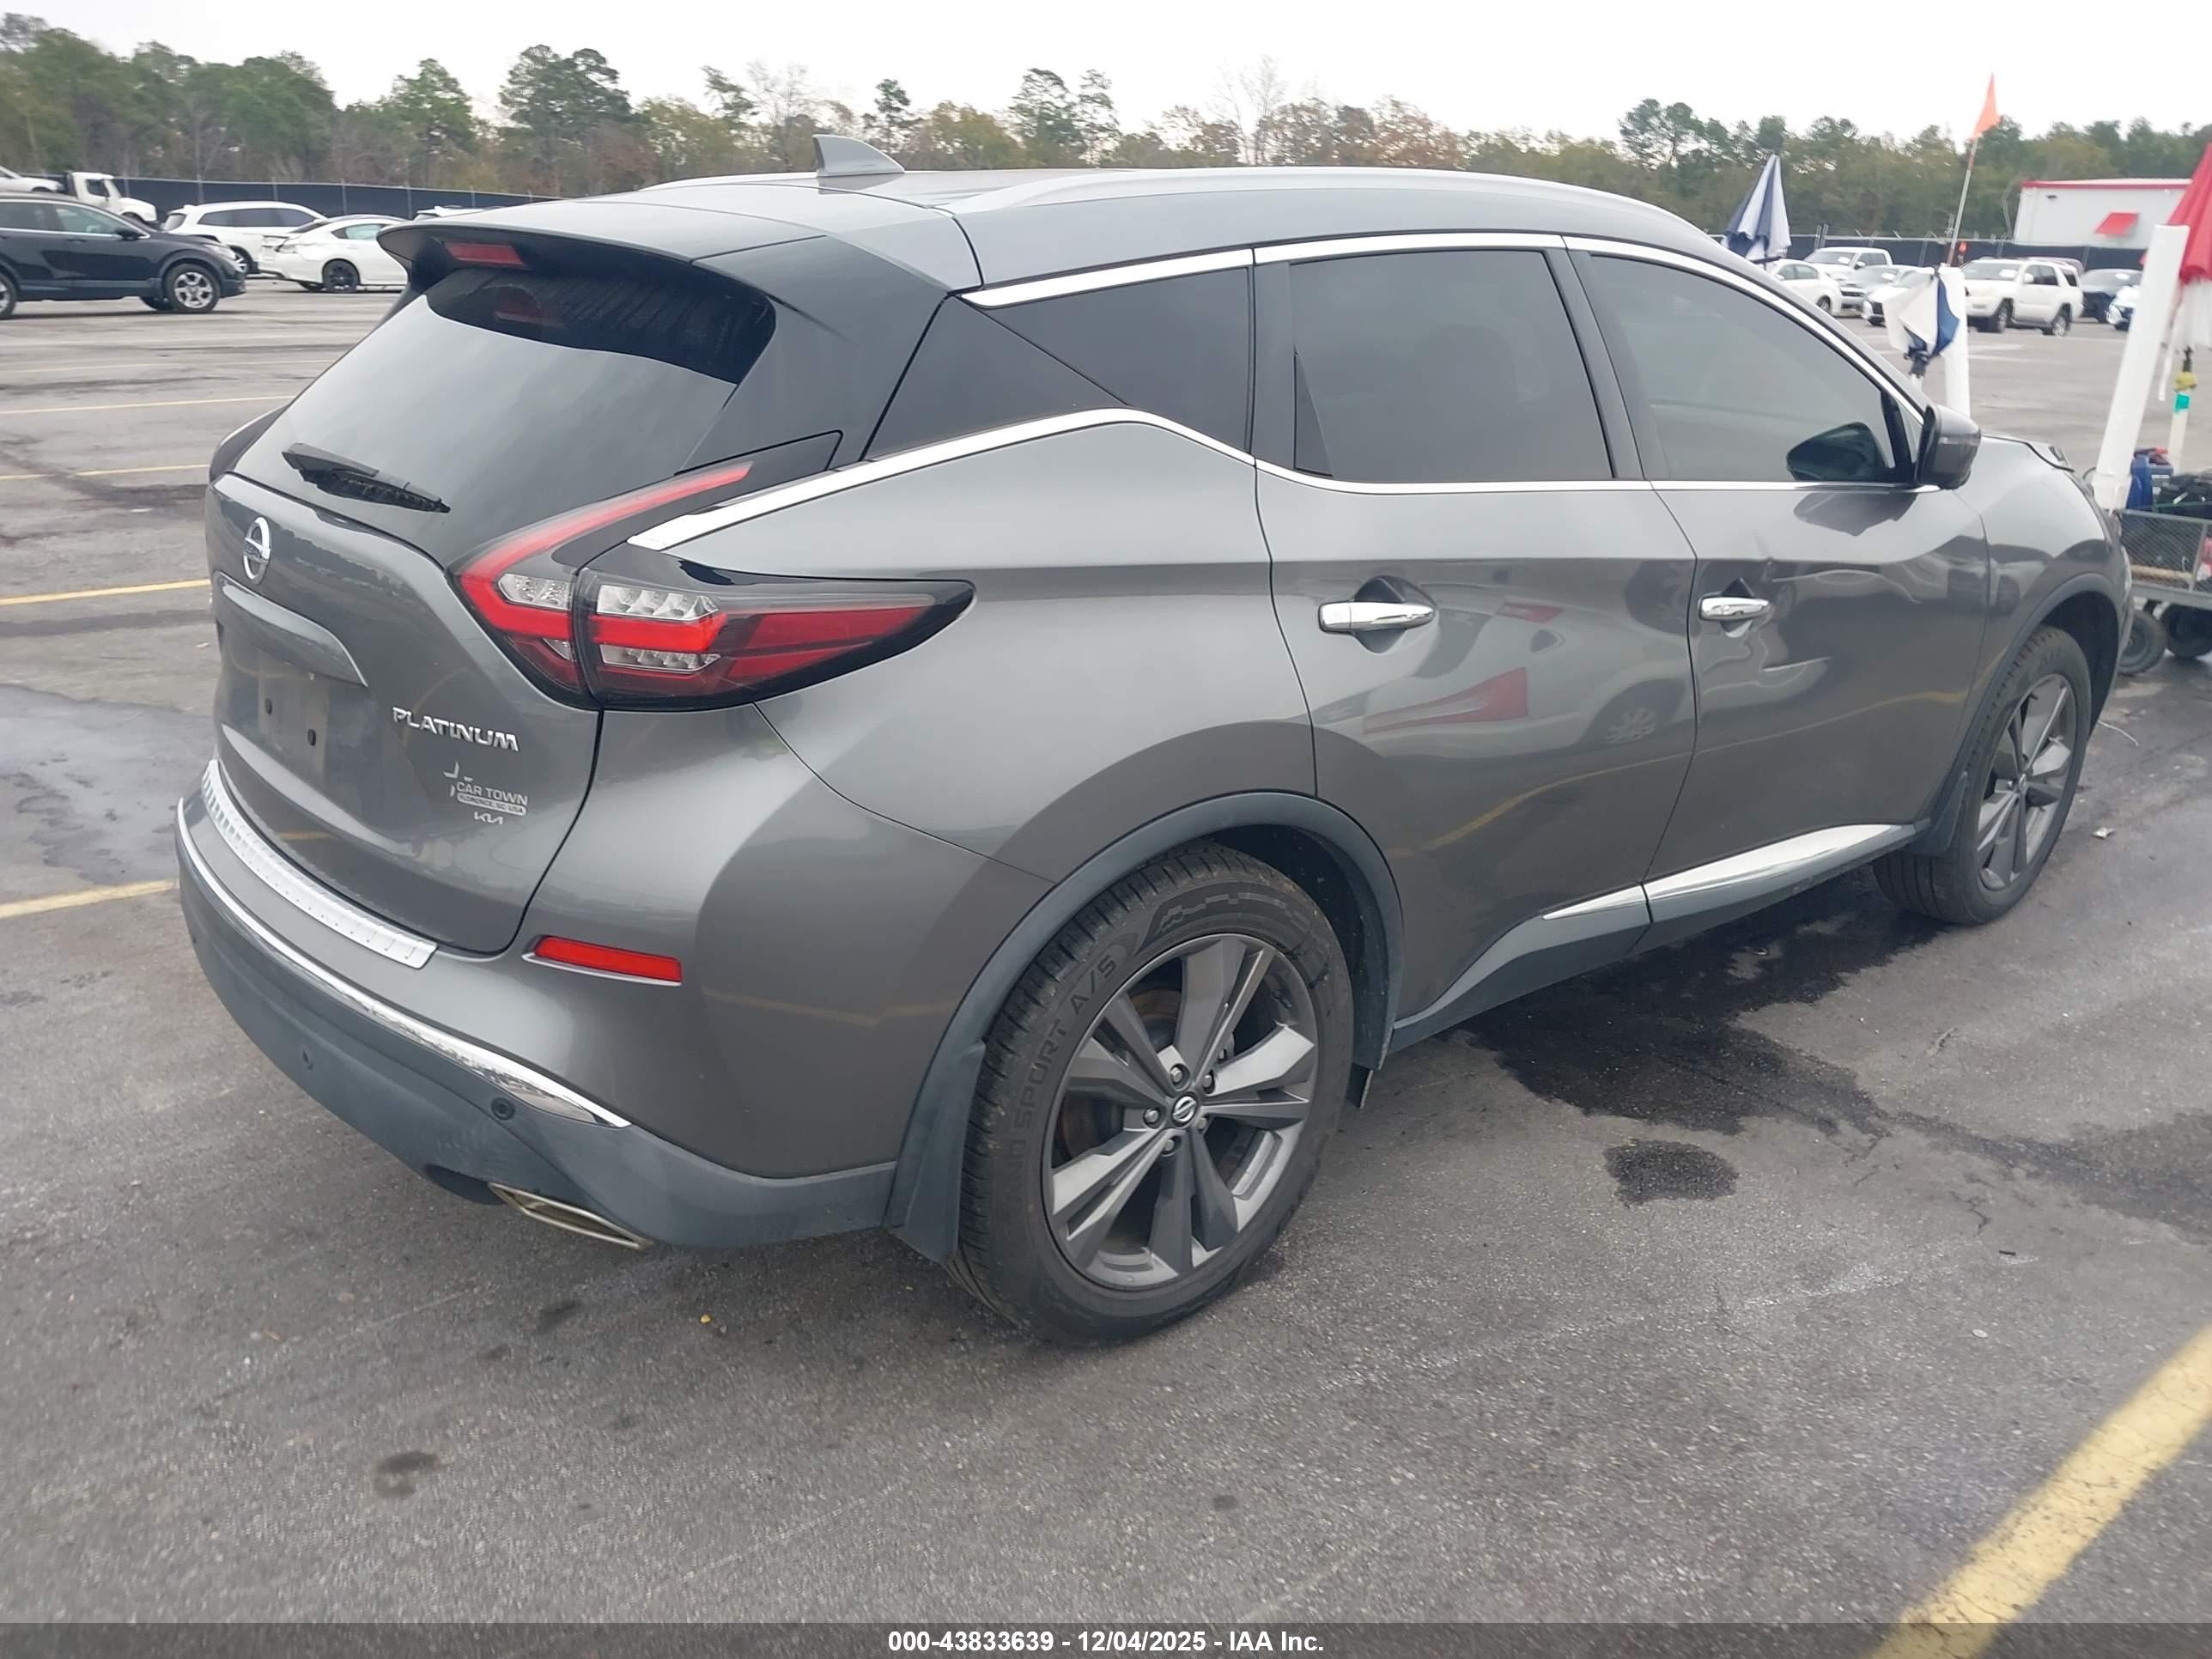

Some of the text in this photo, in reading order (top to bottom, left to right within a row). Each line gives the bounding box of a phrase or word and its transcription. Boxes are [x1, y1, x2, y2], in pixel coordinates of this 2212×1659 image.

[392, 707, 520, 752] PLATINUM
[456, 781, 528, 805] CAR TOWN
[1014, 954, 1117, 1129] SPORT A/S
